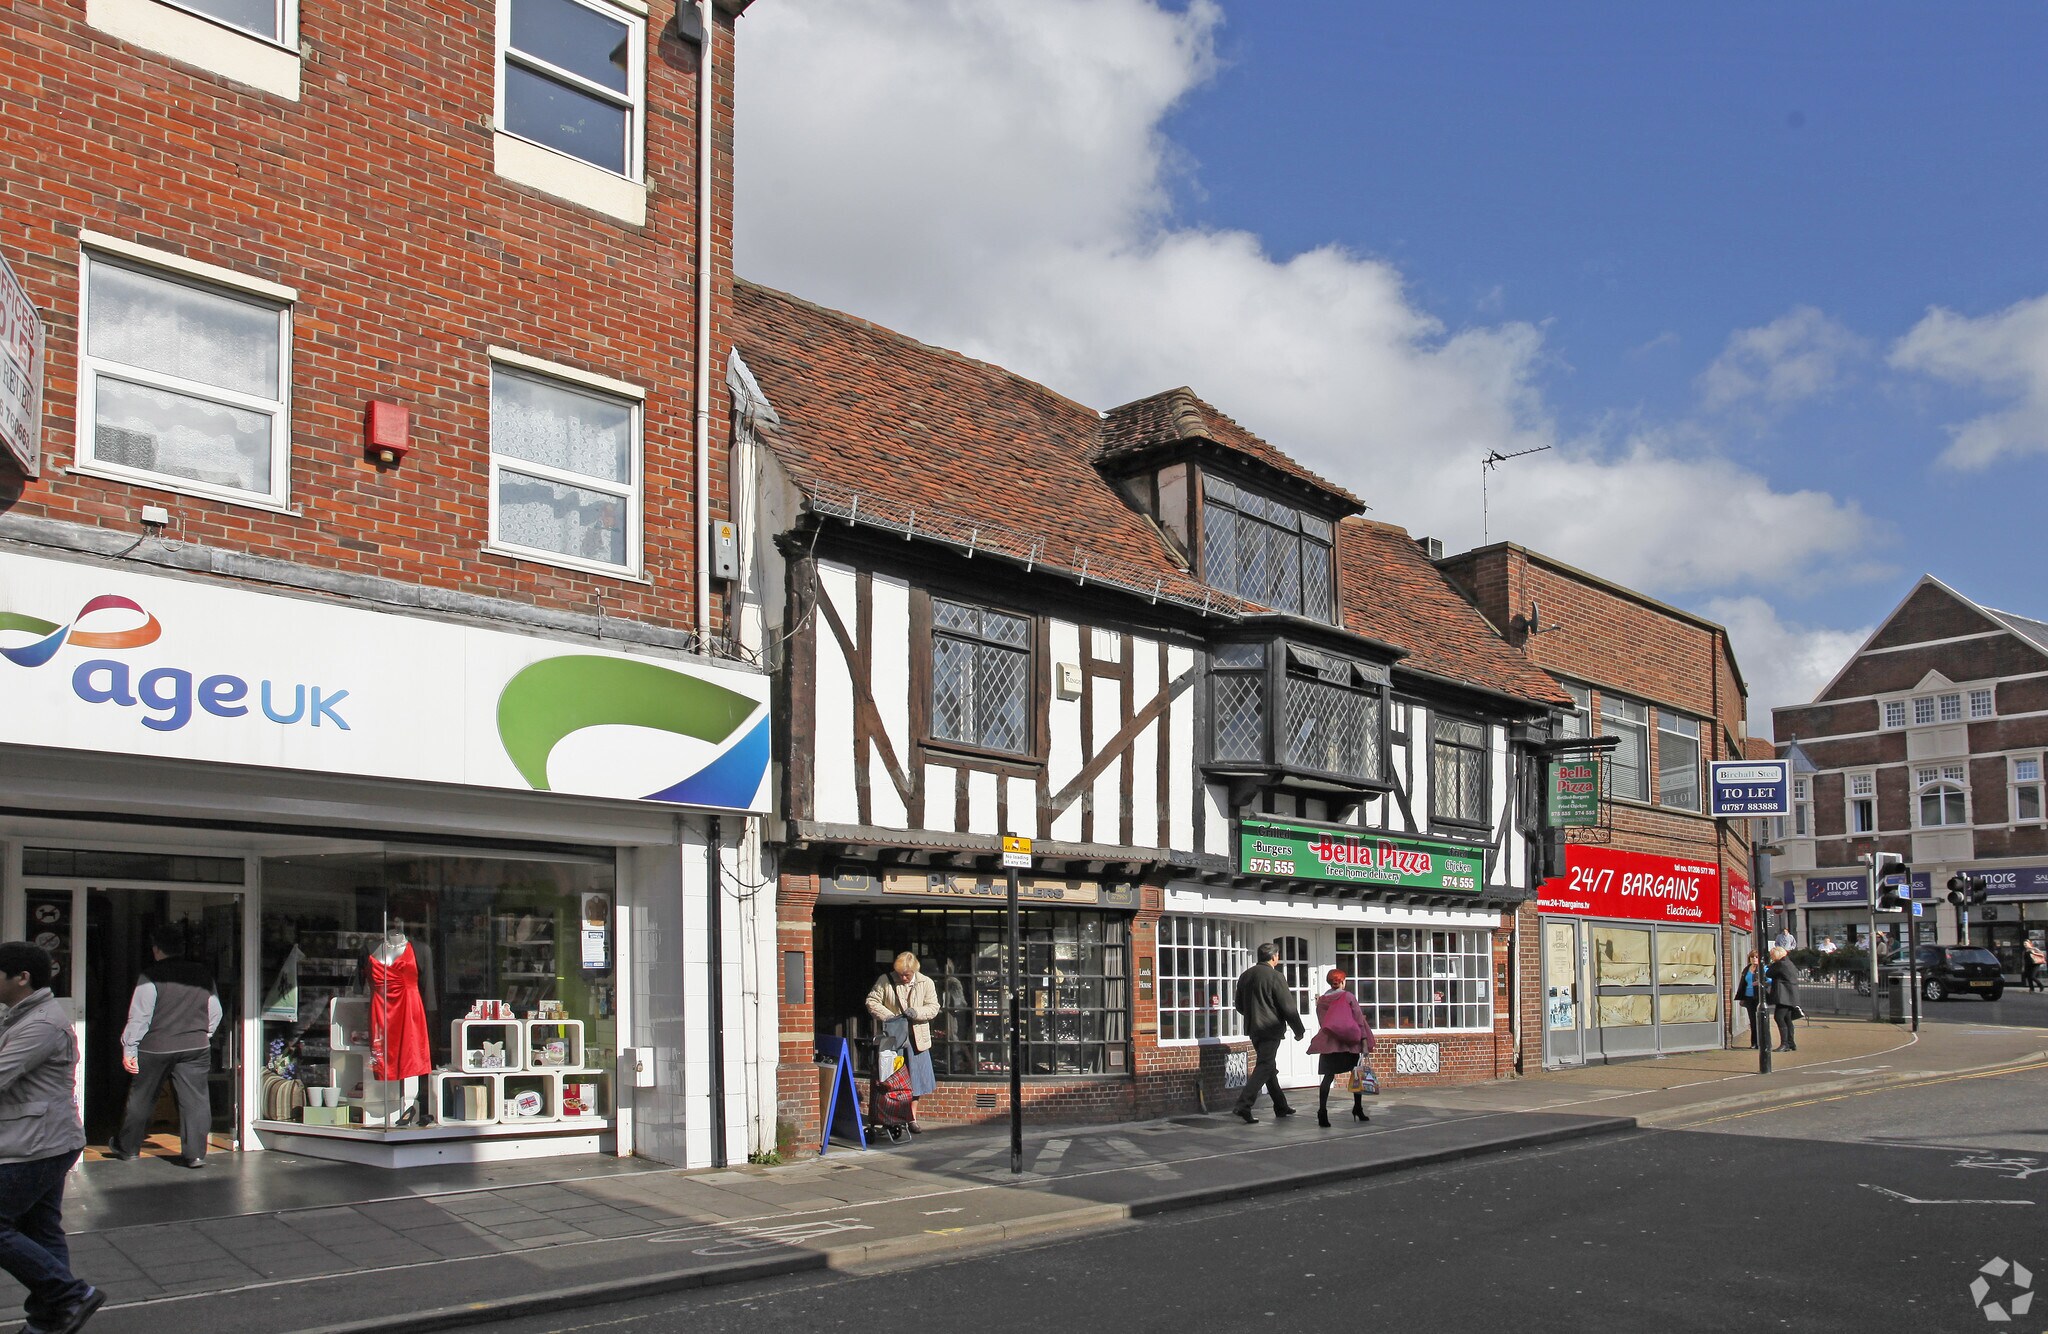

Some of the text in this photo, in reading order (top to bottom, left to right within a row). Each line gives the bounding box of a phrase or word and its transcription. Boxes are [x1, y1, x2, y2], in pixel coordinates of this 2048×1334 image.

[0, 267, 34, 341] FFICES
[10, 319, 34, 375] LET
[6, 406, 30, 450] 760663
[72, 659, 351, 731] age UK
[1553, 765, 1592, 779] Bella
[1720, 770, 1778, 779] Birchall Steel
[1557, 780, 1594, 794] Pizza
[1722, 787, 1776, 799] TO LET
[1721, 802, 1779, 811] 01787 883888
[1252, 840, 1472, 874] Burgers Chicken
[1257, 825, 1291, 839] Grilled
[1308, 832, 1374, 869] Bella
[1376, 838, 1433, 876] Pizza
[926, 873, 1064, 899] P.K. JEWLERS
[1250, 858, 1475, 890] 575 555 free home delivery 574 555
[1568, 865, 1701, 901] 24/7 BARGAINS
[1827, 880, 1859, 891] more
[1980, 872, 2016, 884] more
[1666, 903, 1702, 918] Electricals
